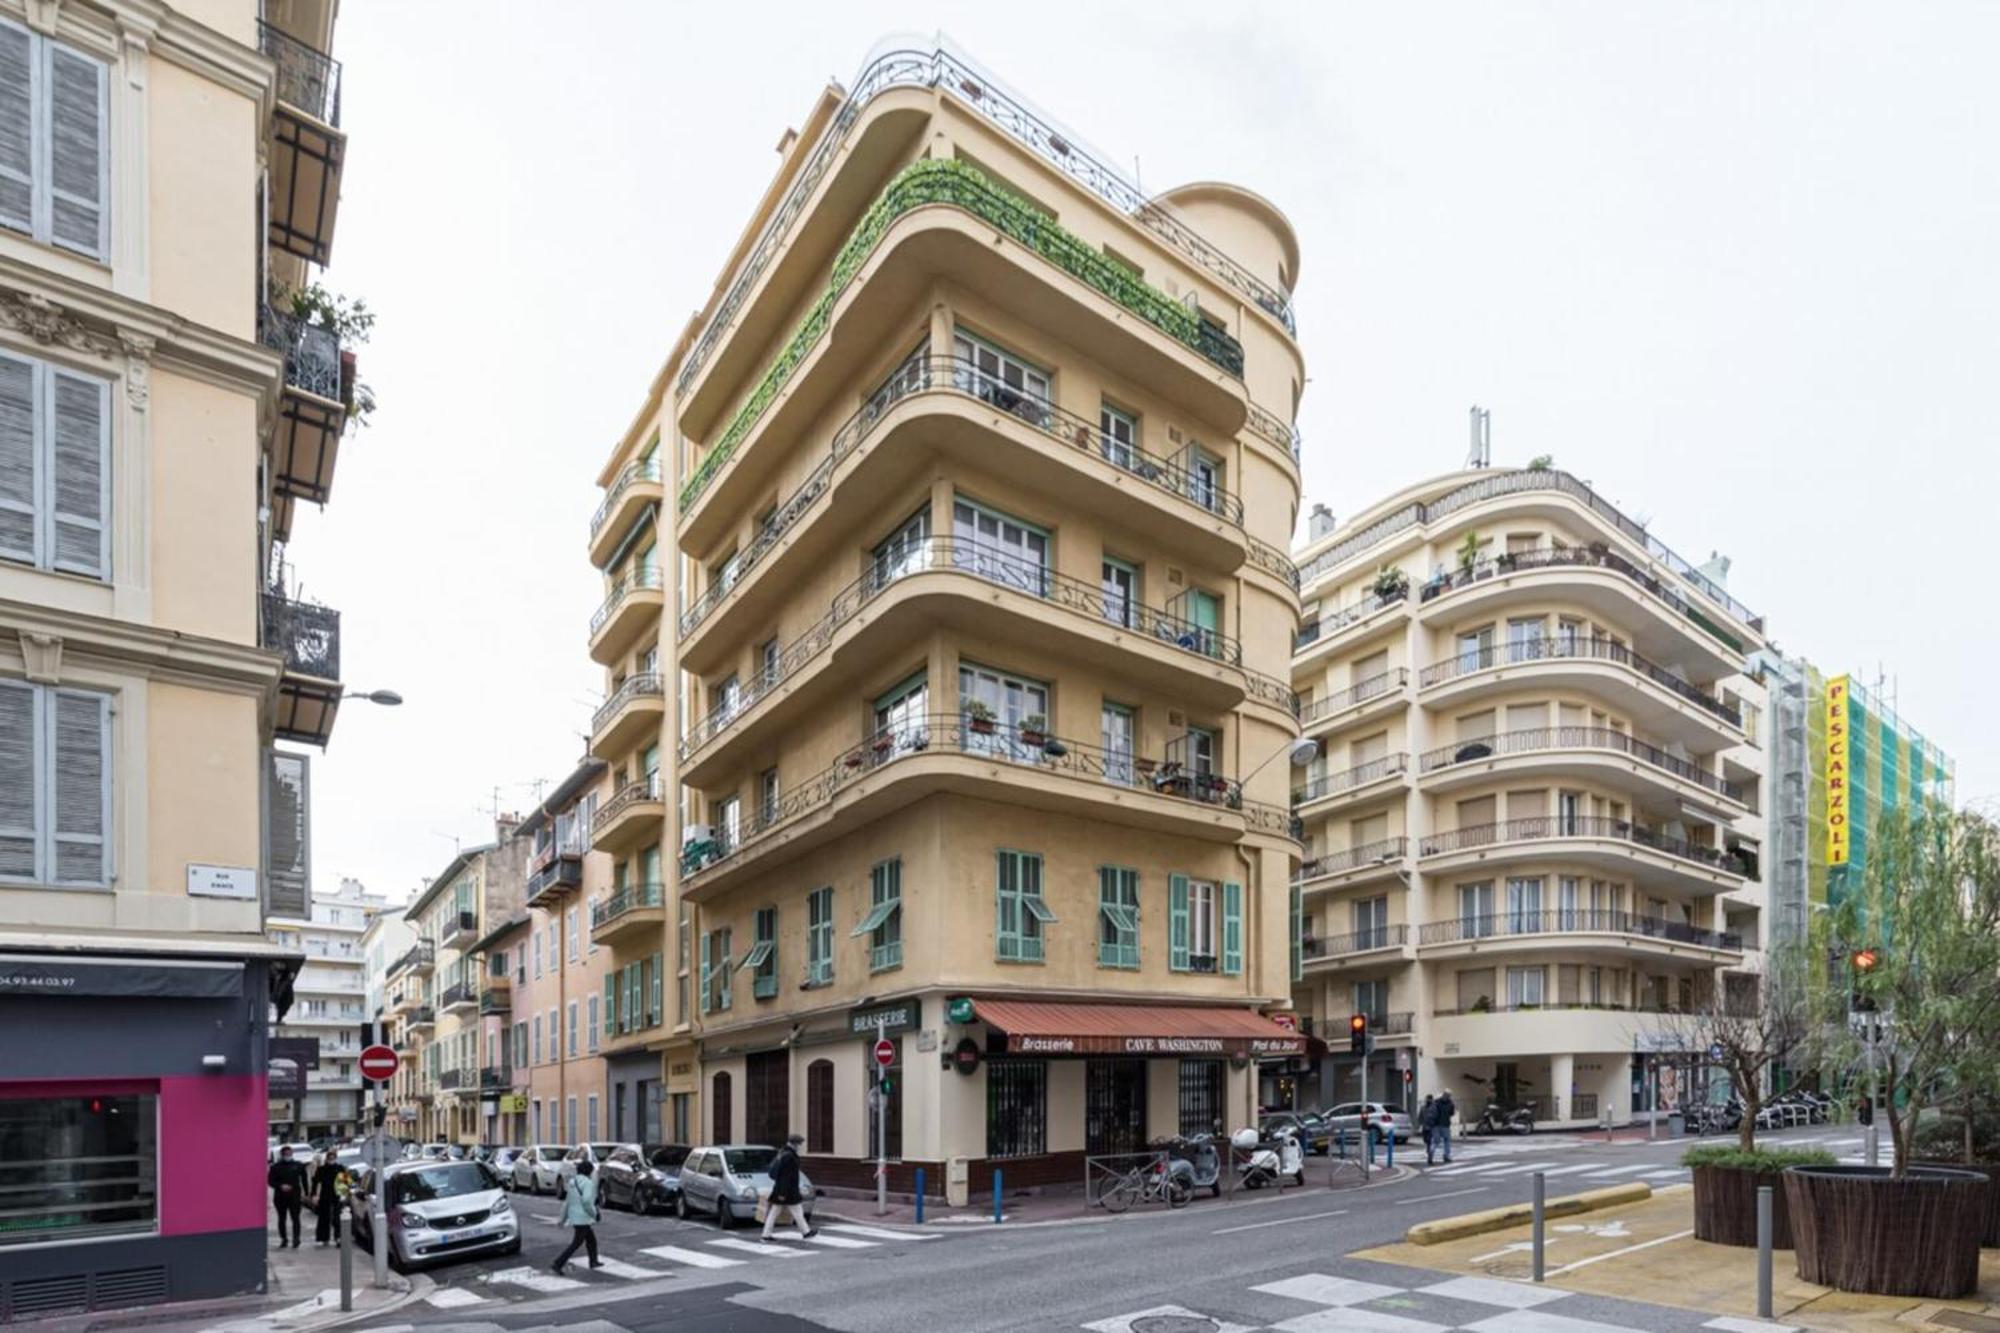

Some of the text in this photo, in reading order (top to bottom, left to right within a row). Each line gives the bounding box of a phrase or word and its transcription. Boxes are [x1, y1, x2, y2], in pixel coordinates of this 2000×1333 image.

[1829, 685, 1845, 863] PESCARZOLI
[853, 1008, 907, 1032] BRASSERIE
[1022, 1037, 1074, 1051] Brasserie
[1157, 1038, 1223, 1052] WASHINGTON
